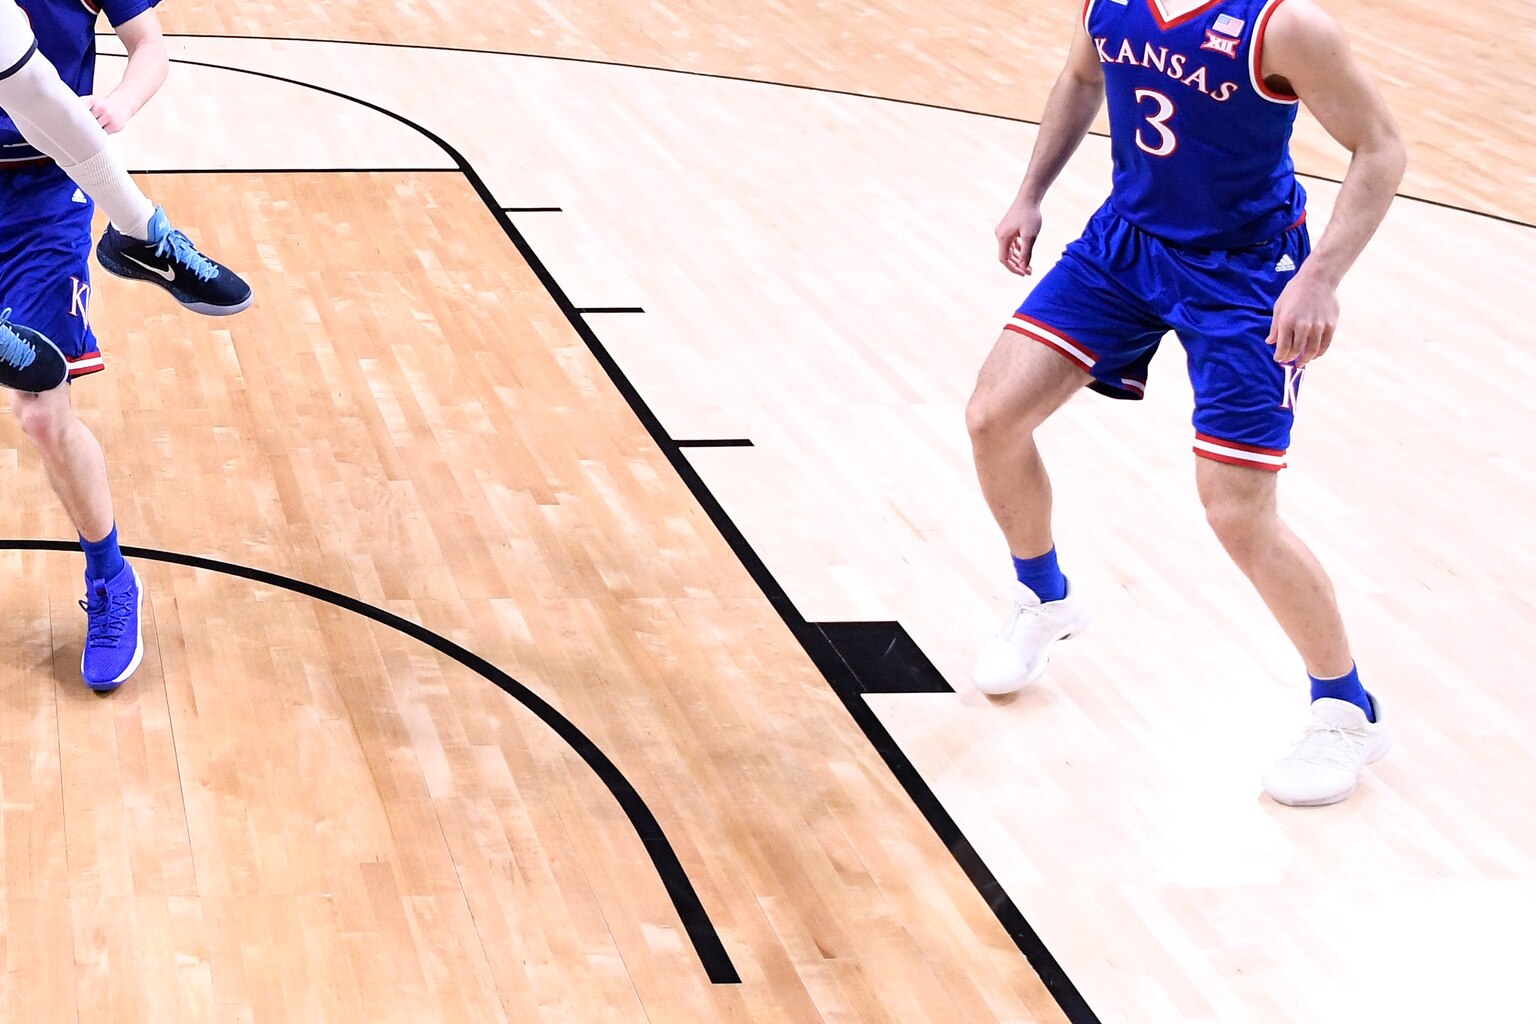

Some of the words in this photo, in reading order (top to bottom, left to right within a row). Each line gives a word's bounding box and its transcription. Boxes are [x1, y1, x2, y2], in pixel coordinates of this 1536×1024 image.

[1093, 36, 1240, 103] KANSAS
[1206, 33, 1239, 57] XII
[1133, 86, 1179, 158] 3
